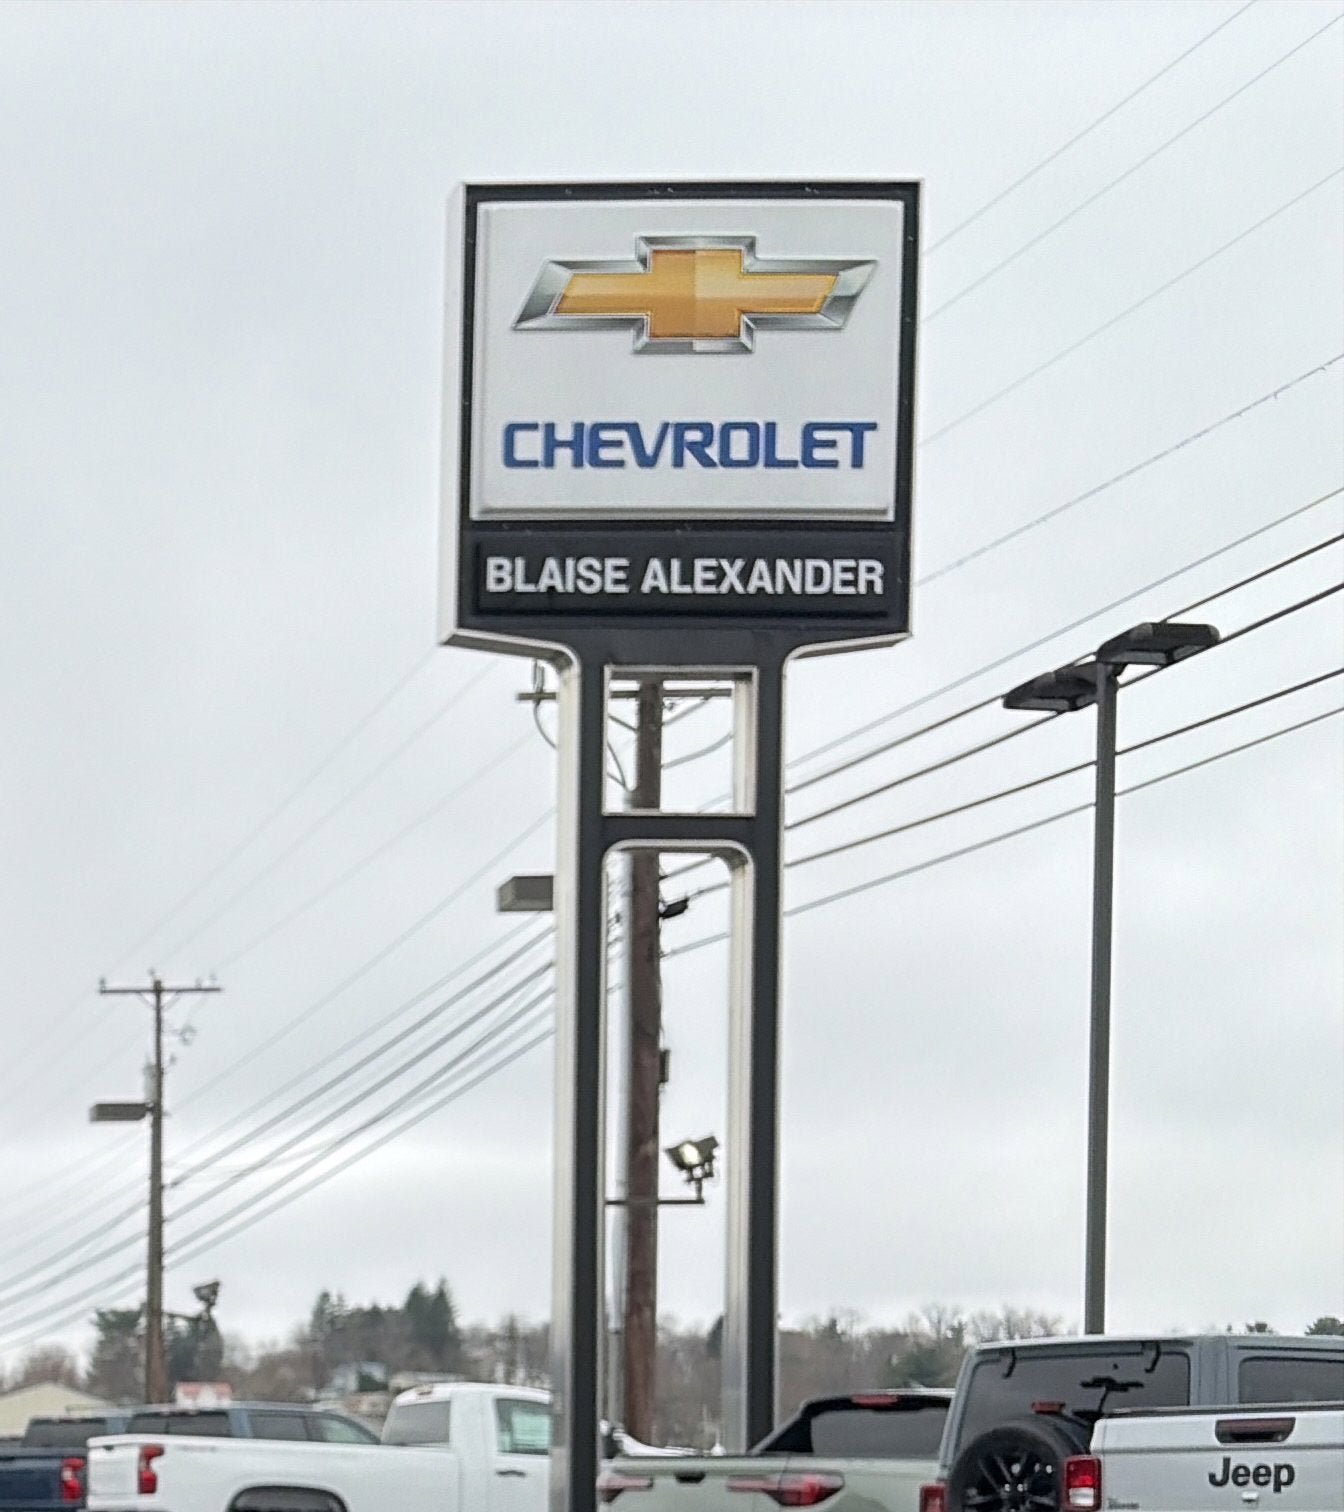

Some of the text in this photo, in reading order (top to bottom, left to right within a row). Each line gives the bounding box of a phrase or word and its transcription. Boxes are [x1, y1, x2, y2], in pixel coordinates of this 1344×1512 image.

[501, 421, 878, 469] CHEVROLET
[485, 556, 885, 596] BLAISE ALEXANDER
[1208, 1456, 1296, 1494] Jeep
